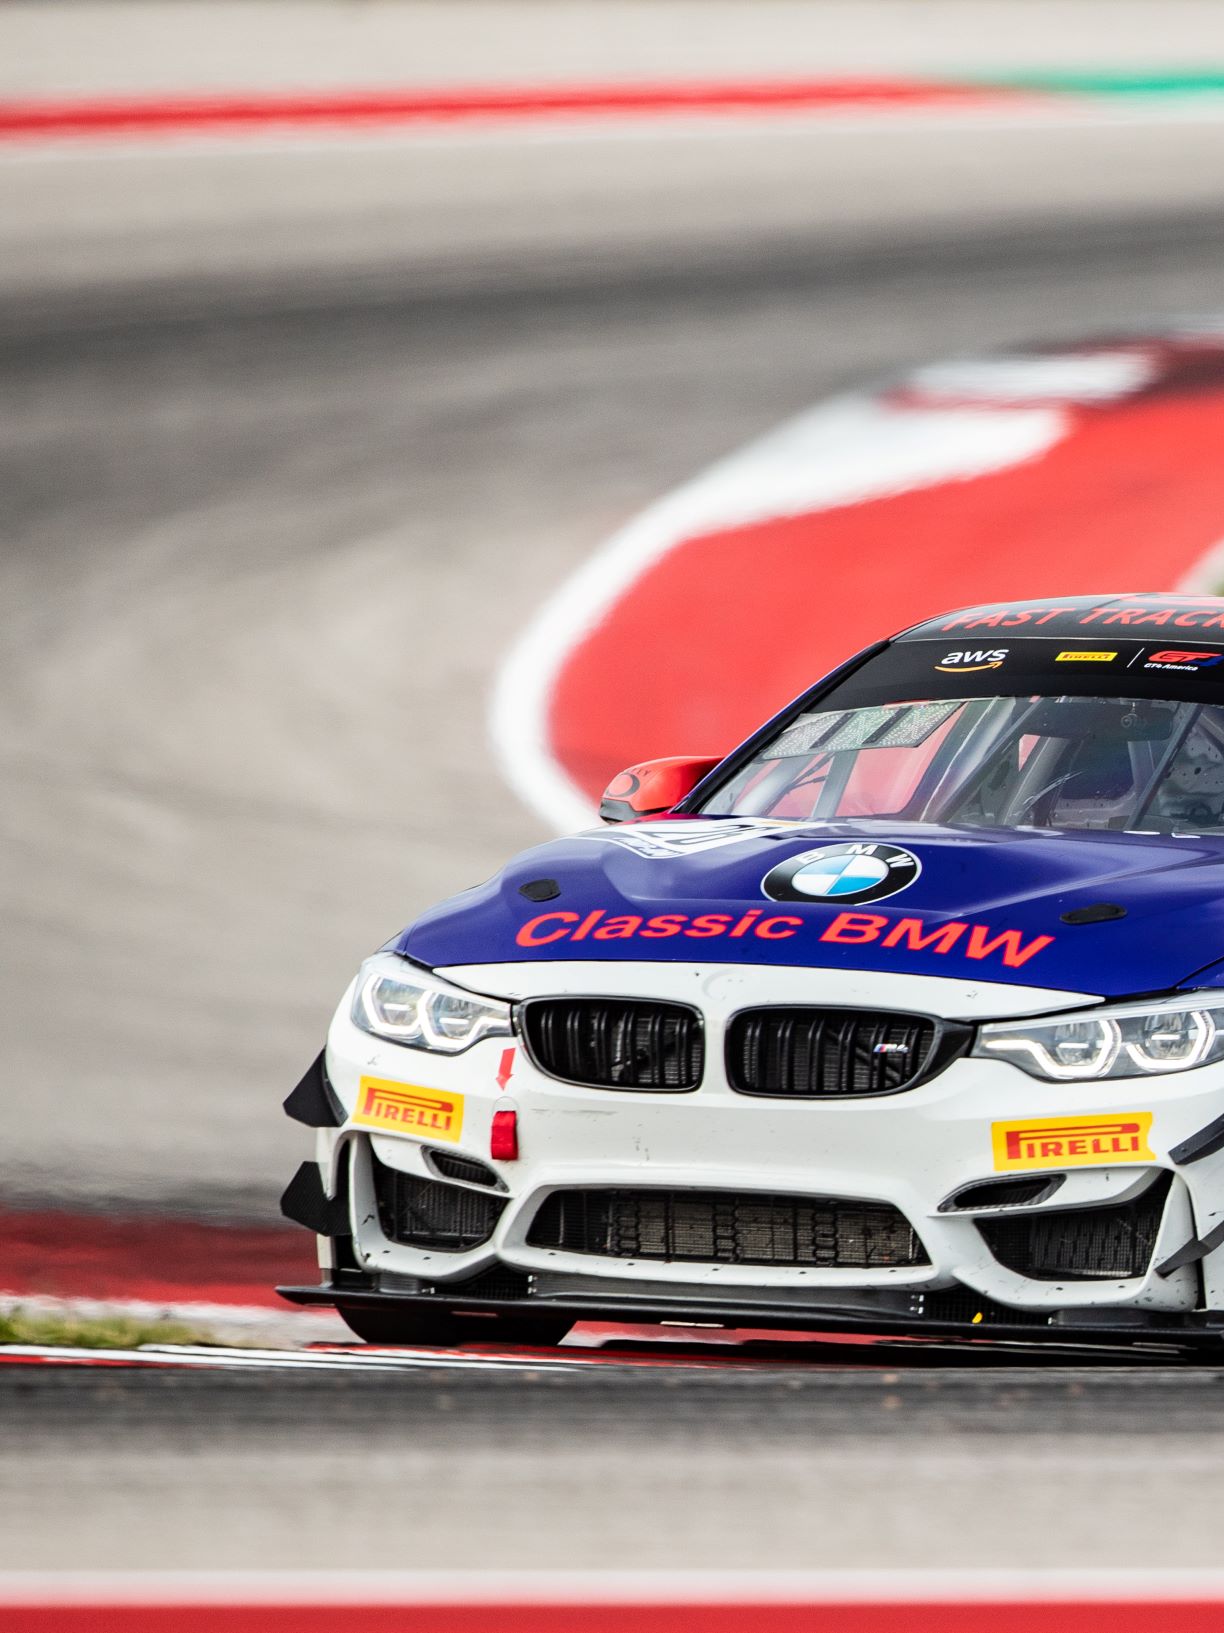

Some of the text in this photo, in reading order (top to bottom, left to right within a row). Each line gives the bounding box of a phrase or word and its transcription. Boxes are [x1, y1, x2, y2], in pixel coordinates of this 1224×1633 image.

[941, 608, 1076, 632] FAST
[941, 649, 1010, 665] aws
[795, 843, 915, 869] BMW
[515, 908, 1055, 969] Classic BMW
[362, 1086, 454, 1132] PIRELLI
[1006, 1121, 1141, 1159] PIRELLI
